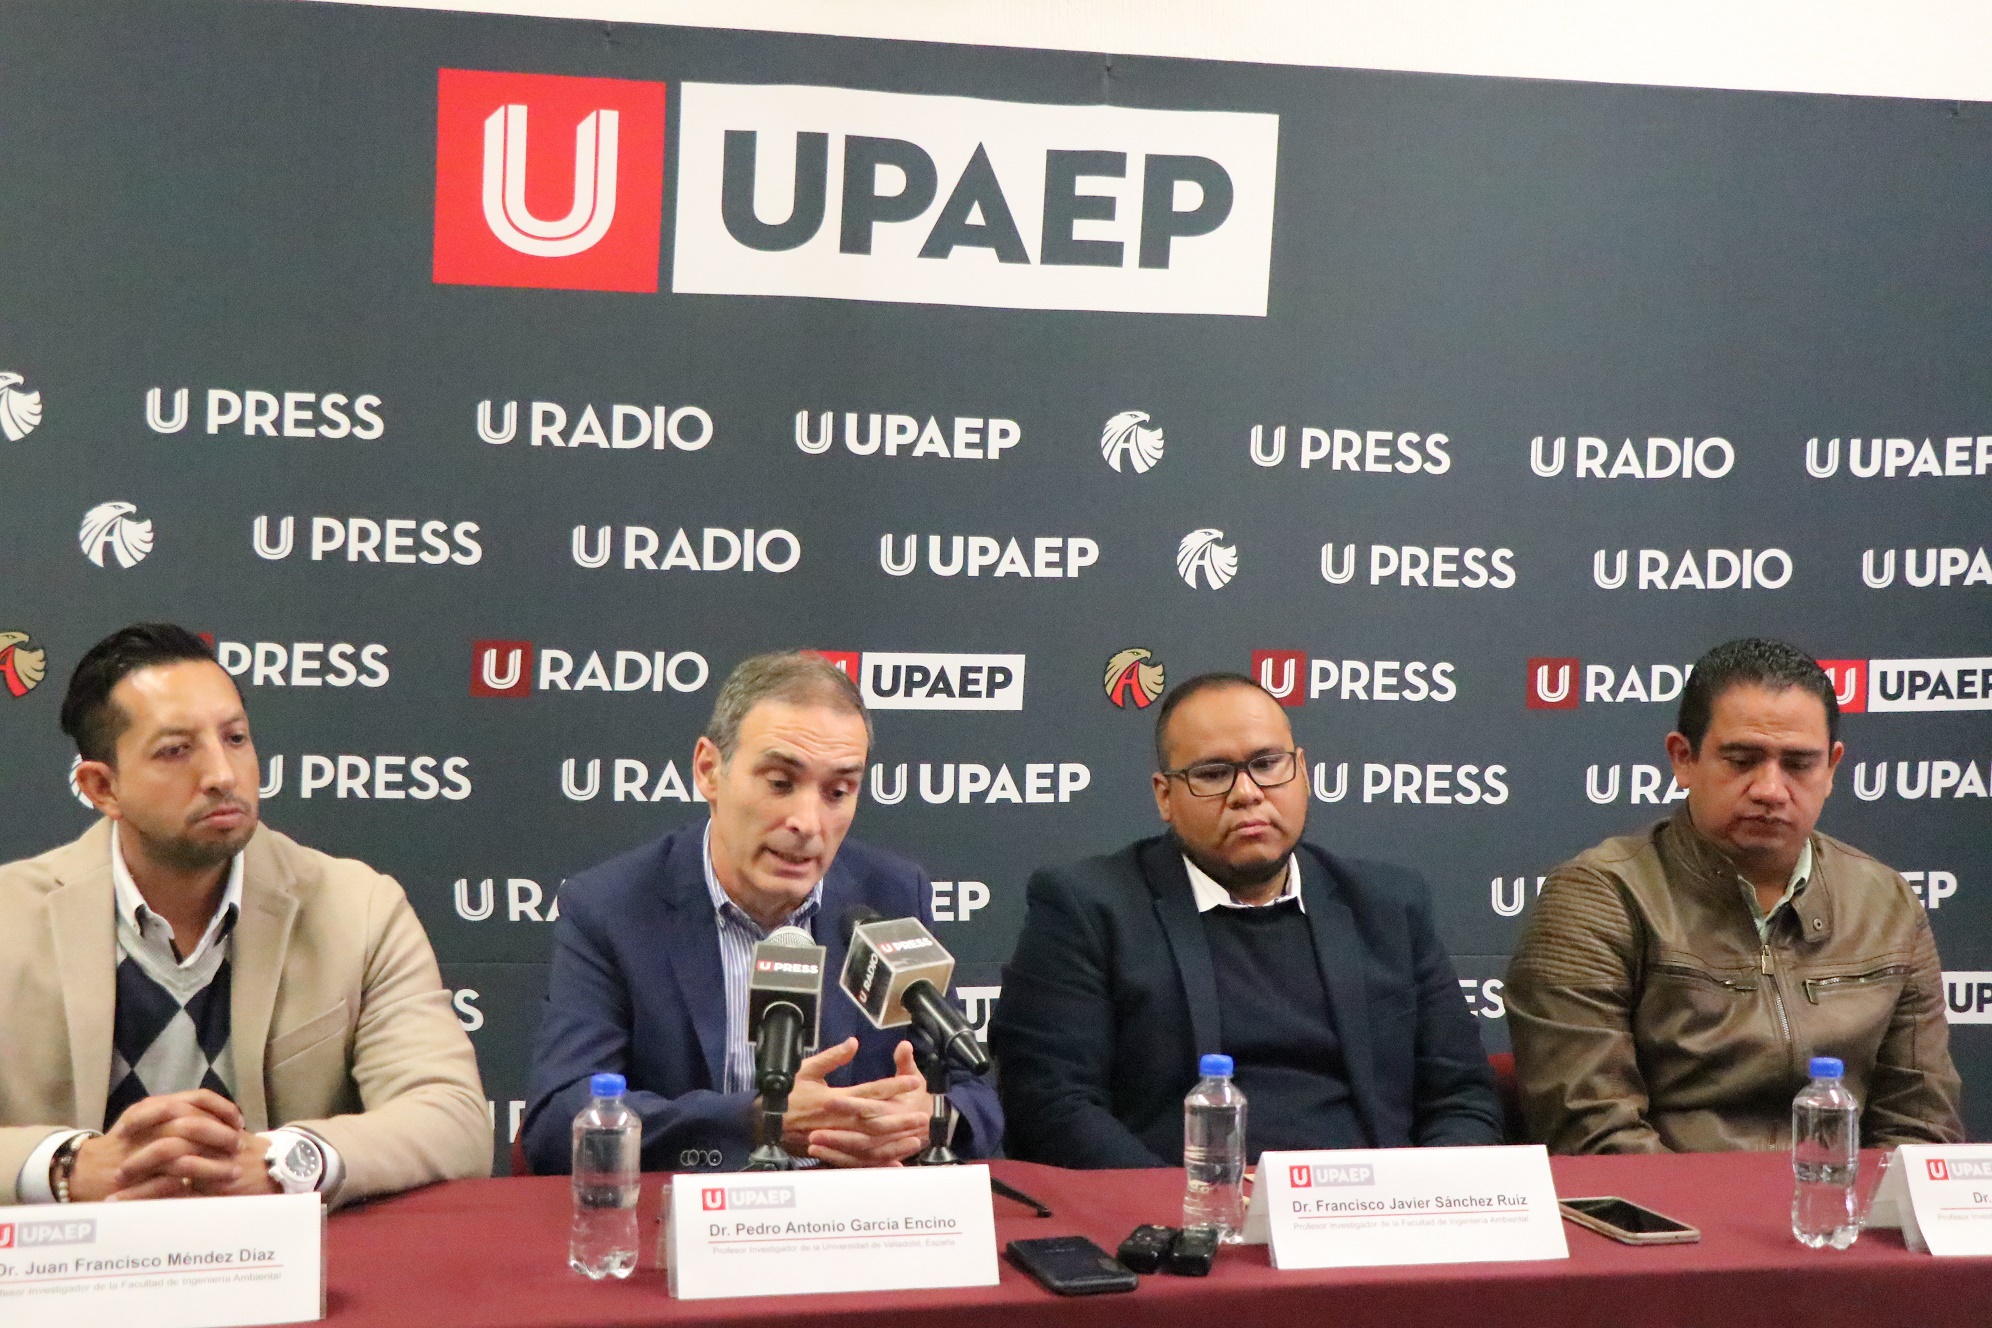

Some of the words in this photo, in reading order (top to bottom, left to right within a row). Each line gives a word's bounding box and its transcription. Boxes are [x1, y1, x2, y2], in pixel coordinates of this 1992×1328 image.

[482, 104, 619, 257] U
[721, 129, 1235, 270] UPAEP
[146, 388, 188, 433] U
[207, 389, 384, 440] PRESS
[477, 400, 517, 444] U
[531, 402, 713, 451] RADIO
[796, 411, 833, 454] U
[845, 413, 1021, 460] UPAEP
[1250, 425, 1285, 466] U
[1301, 428, 1450, 474] PRESS
[1531, 437, 1565, 477] U
[1577, 437, 1734, 479] RADIO
[1806, 438, 1839, 478] U
[254, 516, 294, 559] U
[312, 517, 482, 565] PRESS
[573, 525, 611, 568] U
[625, 526, 800, 572] RADIO
[881, 534, 917, 576] U
[929, 535, 1099, 577] UPAEP
[1321, 543, 1355, 584] U
[1371, 545, 1515, 588] PRESS
[1594, 550, 1627, 589] U
[1639, 549, 1792, 589] RADIO
[1863, 550, 1895, 588] U
[483, 649, 521, 689] U
[540, 650, 708, 692] RADIO
[872, 665, 1013, 698] UPAEP
[1260, 657, 1295, 699] U
[1311, 660, 1456, 702] PRESS
[1537, 666, 1569, 702] U
[301, 755, 472, 800] PRESS
[562, 759, 600, 801] U
[871, 763, 907, 804] U
[920, 763, 1091, 803] UPAEP
[1314, 763, 1348, 802] U
[1364, 764, 1509, 804] PRESS
[1586, 765, 1620, 804] U
[1854, 762, 1887, 801] U
[1897, 760, 1992, 799] UPA
[455, 879, 494, 921] U
[893, 938, 933, 950] PRESS
[774, 963, 818, 974] PRESS
[864, 953, 879, 988] RADIO
[1316, 1167, 1370, 1183] UPAEP
[731, 1189, 791, 1206] UPAEP
[1292, 1200, 1311, 1212] Dr.
[1316, 1199, 1384, 1212] Francisco
[1390, 1197, 1430, 1209] Javier
[1435, 1195, 1493, 1208] Sánchez
[1497, 1194, 1528, 1206] Ruiz
[22, 1223, 92, 1242] UPAEP
[710, 1223, 730, 1237] Dr.
[736, 1222, 781, 1235] Pedro
[786, 1219, 845, 1234] Antonio
[904, 1216, 956, 1229] Encino
[26, 1261, 68, 1275] Juan
[75, 1256, 162, 1272] Francisco
[168, 1250, 233, 1266] Méndez
